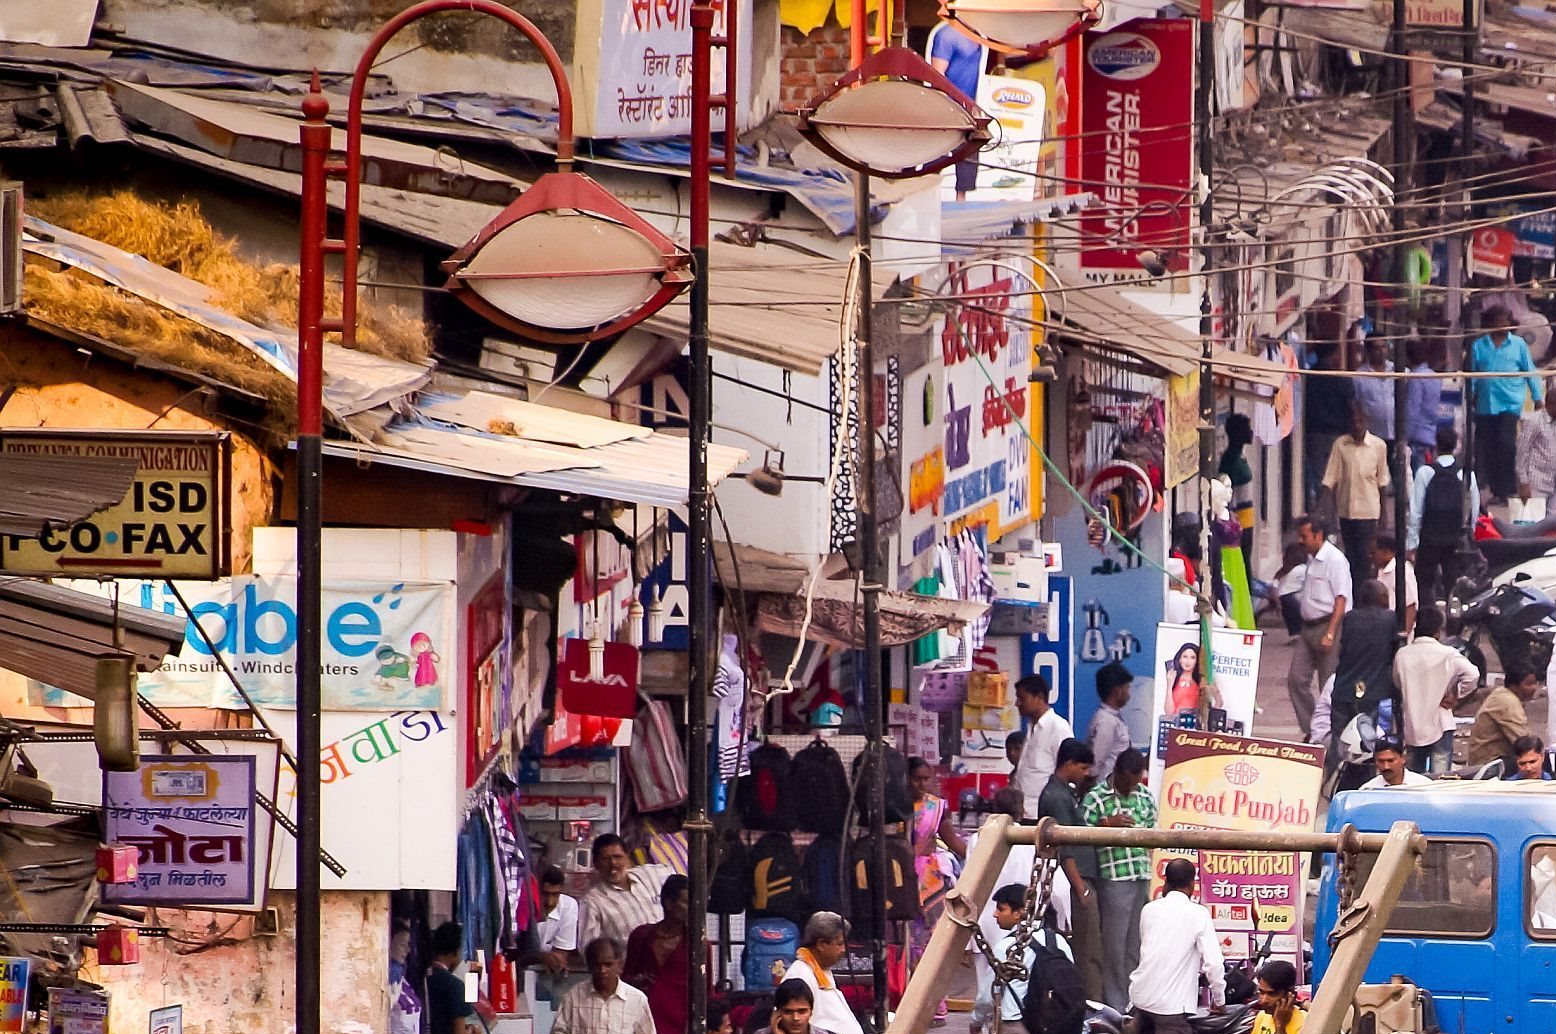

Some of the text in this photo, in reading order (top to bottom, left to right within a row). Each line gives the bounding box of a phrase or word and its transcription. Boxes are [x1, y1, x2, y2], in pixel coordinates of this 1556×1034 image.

[643, 47, 671, 76] डिनर
[1103, 90, 1122, 251] AMERICAN
[1085, 272, 1111, 283] MY
[133, 481, 208, 514] ISD
[1007, 477, 1028, 517] FAN
[121, 523, 208, 555] FAX
[1212, 654, 1253, 669] PERFECT
[1175, 733, 1207, 747] Great
[1247, 742, 1279, 756] Great
[1167, 780, 1311, 830] Great Punjab
